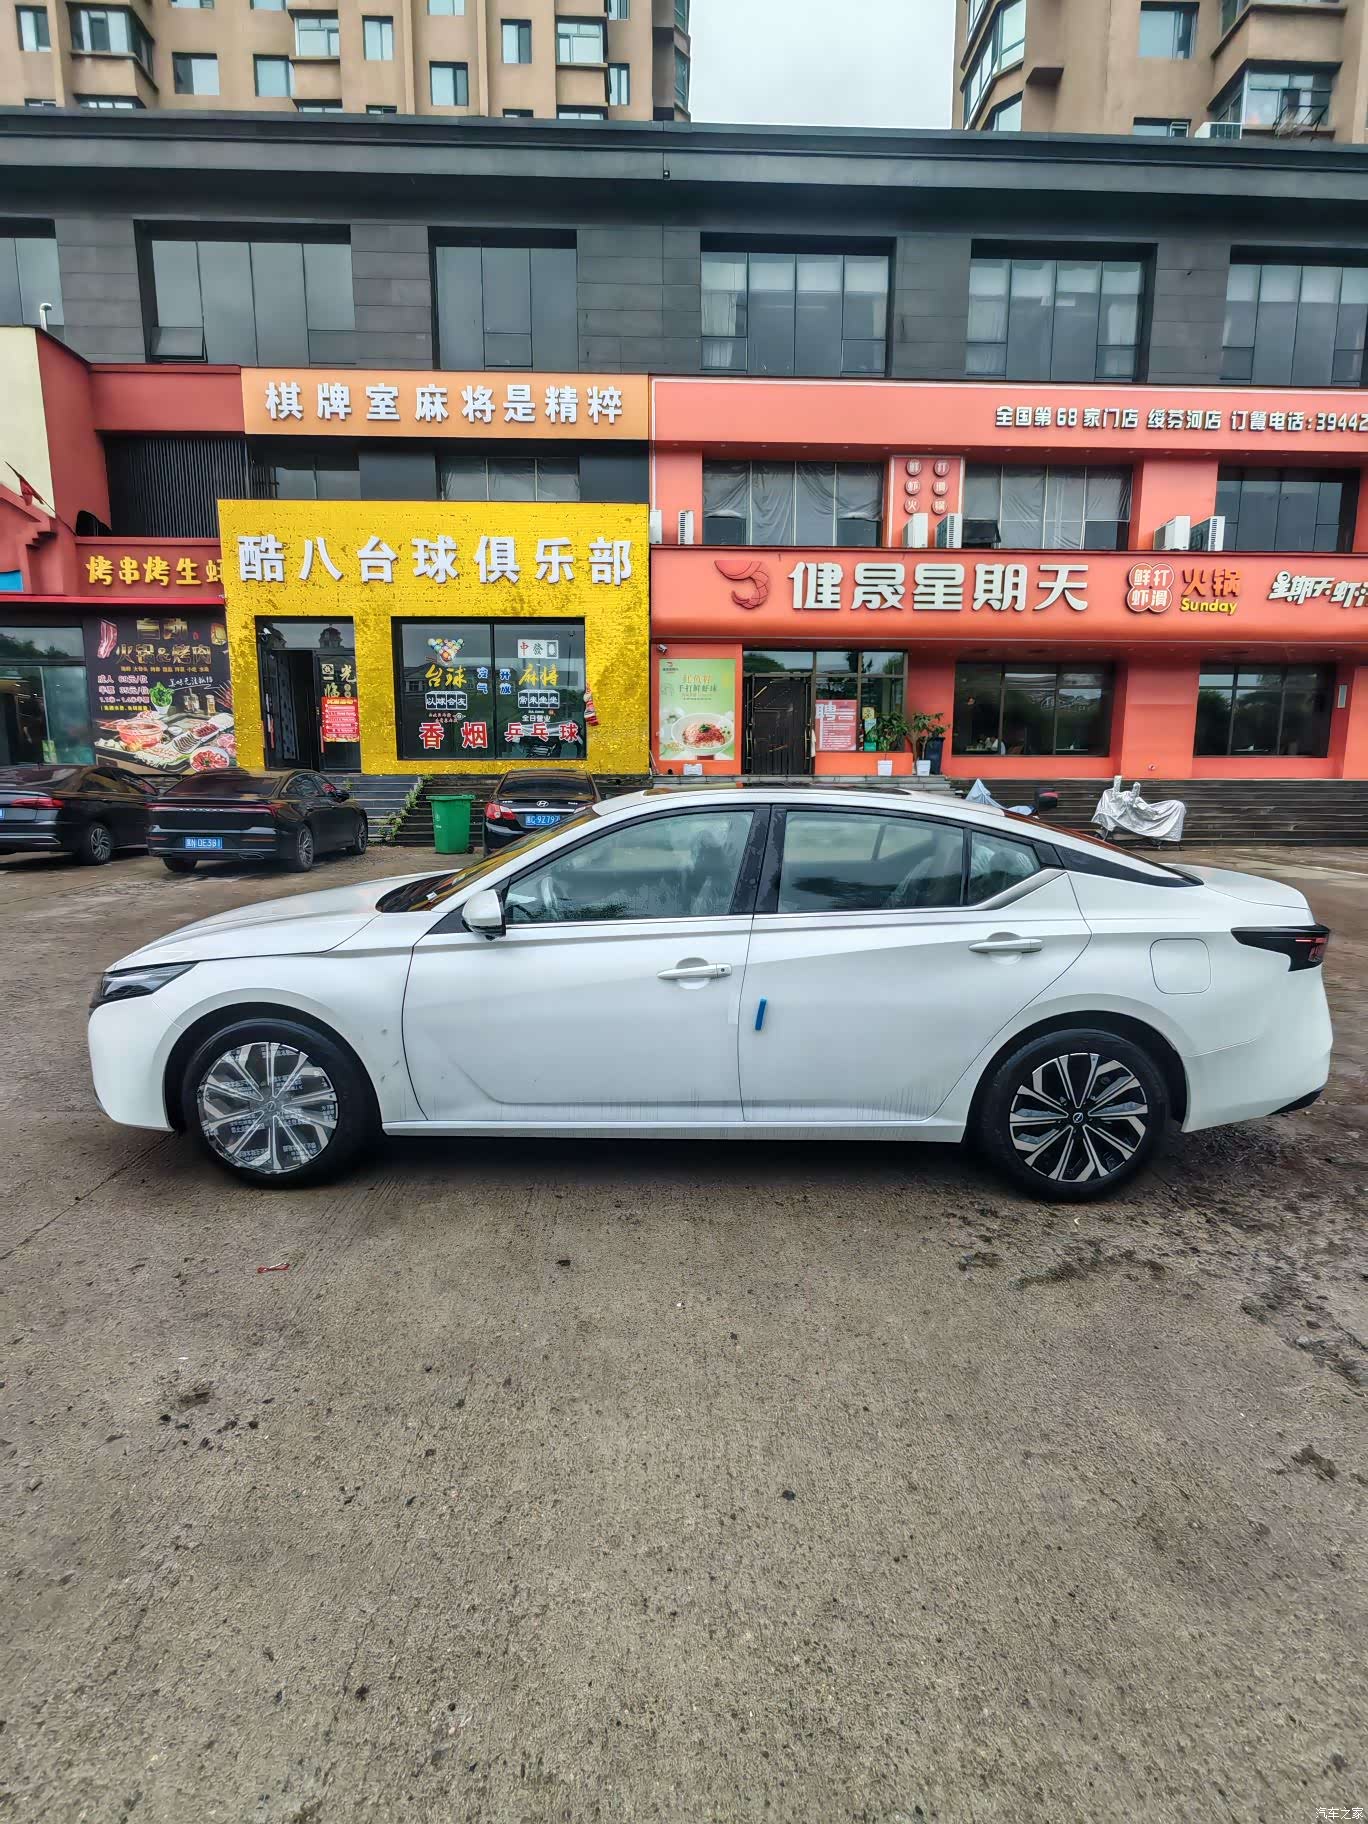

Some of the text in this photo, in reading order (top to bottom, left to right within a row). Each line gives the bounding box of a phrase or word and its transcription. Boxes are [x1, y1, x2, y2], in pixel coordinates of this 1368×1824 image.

[265, 381, 623, 425] 棋牌室麻将是精粹
[1147, 408, 1221, 430] 绥芬河店
[238, 534, 632, 586] 酷八台球俱乐部
[788, 561, 1089, 611] 健晟星期天
[1134, 569, 1170, 586] 鲜打
[1181, 568, 1240, 598] 火锅
[1132, 589, 1168, 606] 虾滑
[1180, 598, 1238, 616] Sunday
[425, 663, 467, 688] 台球
[518, 662, 559, 687] 麻将
[426, 696, 467, 707] 以球会友
[519, 694, 559, 706] 常来坐坐
[418, 721, 489, 750] 香烟
[504, 722, 579, 743] 乒乓球
